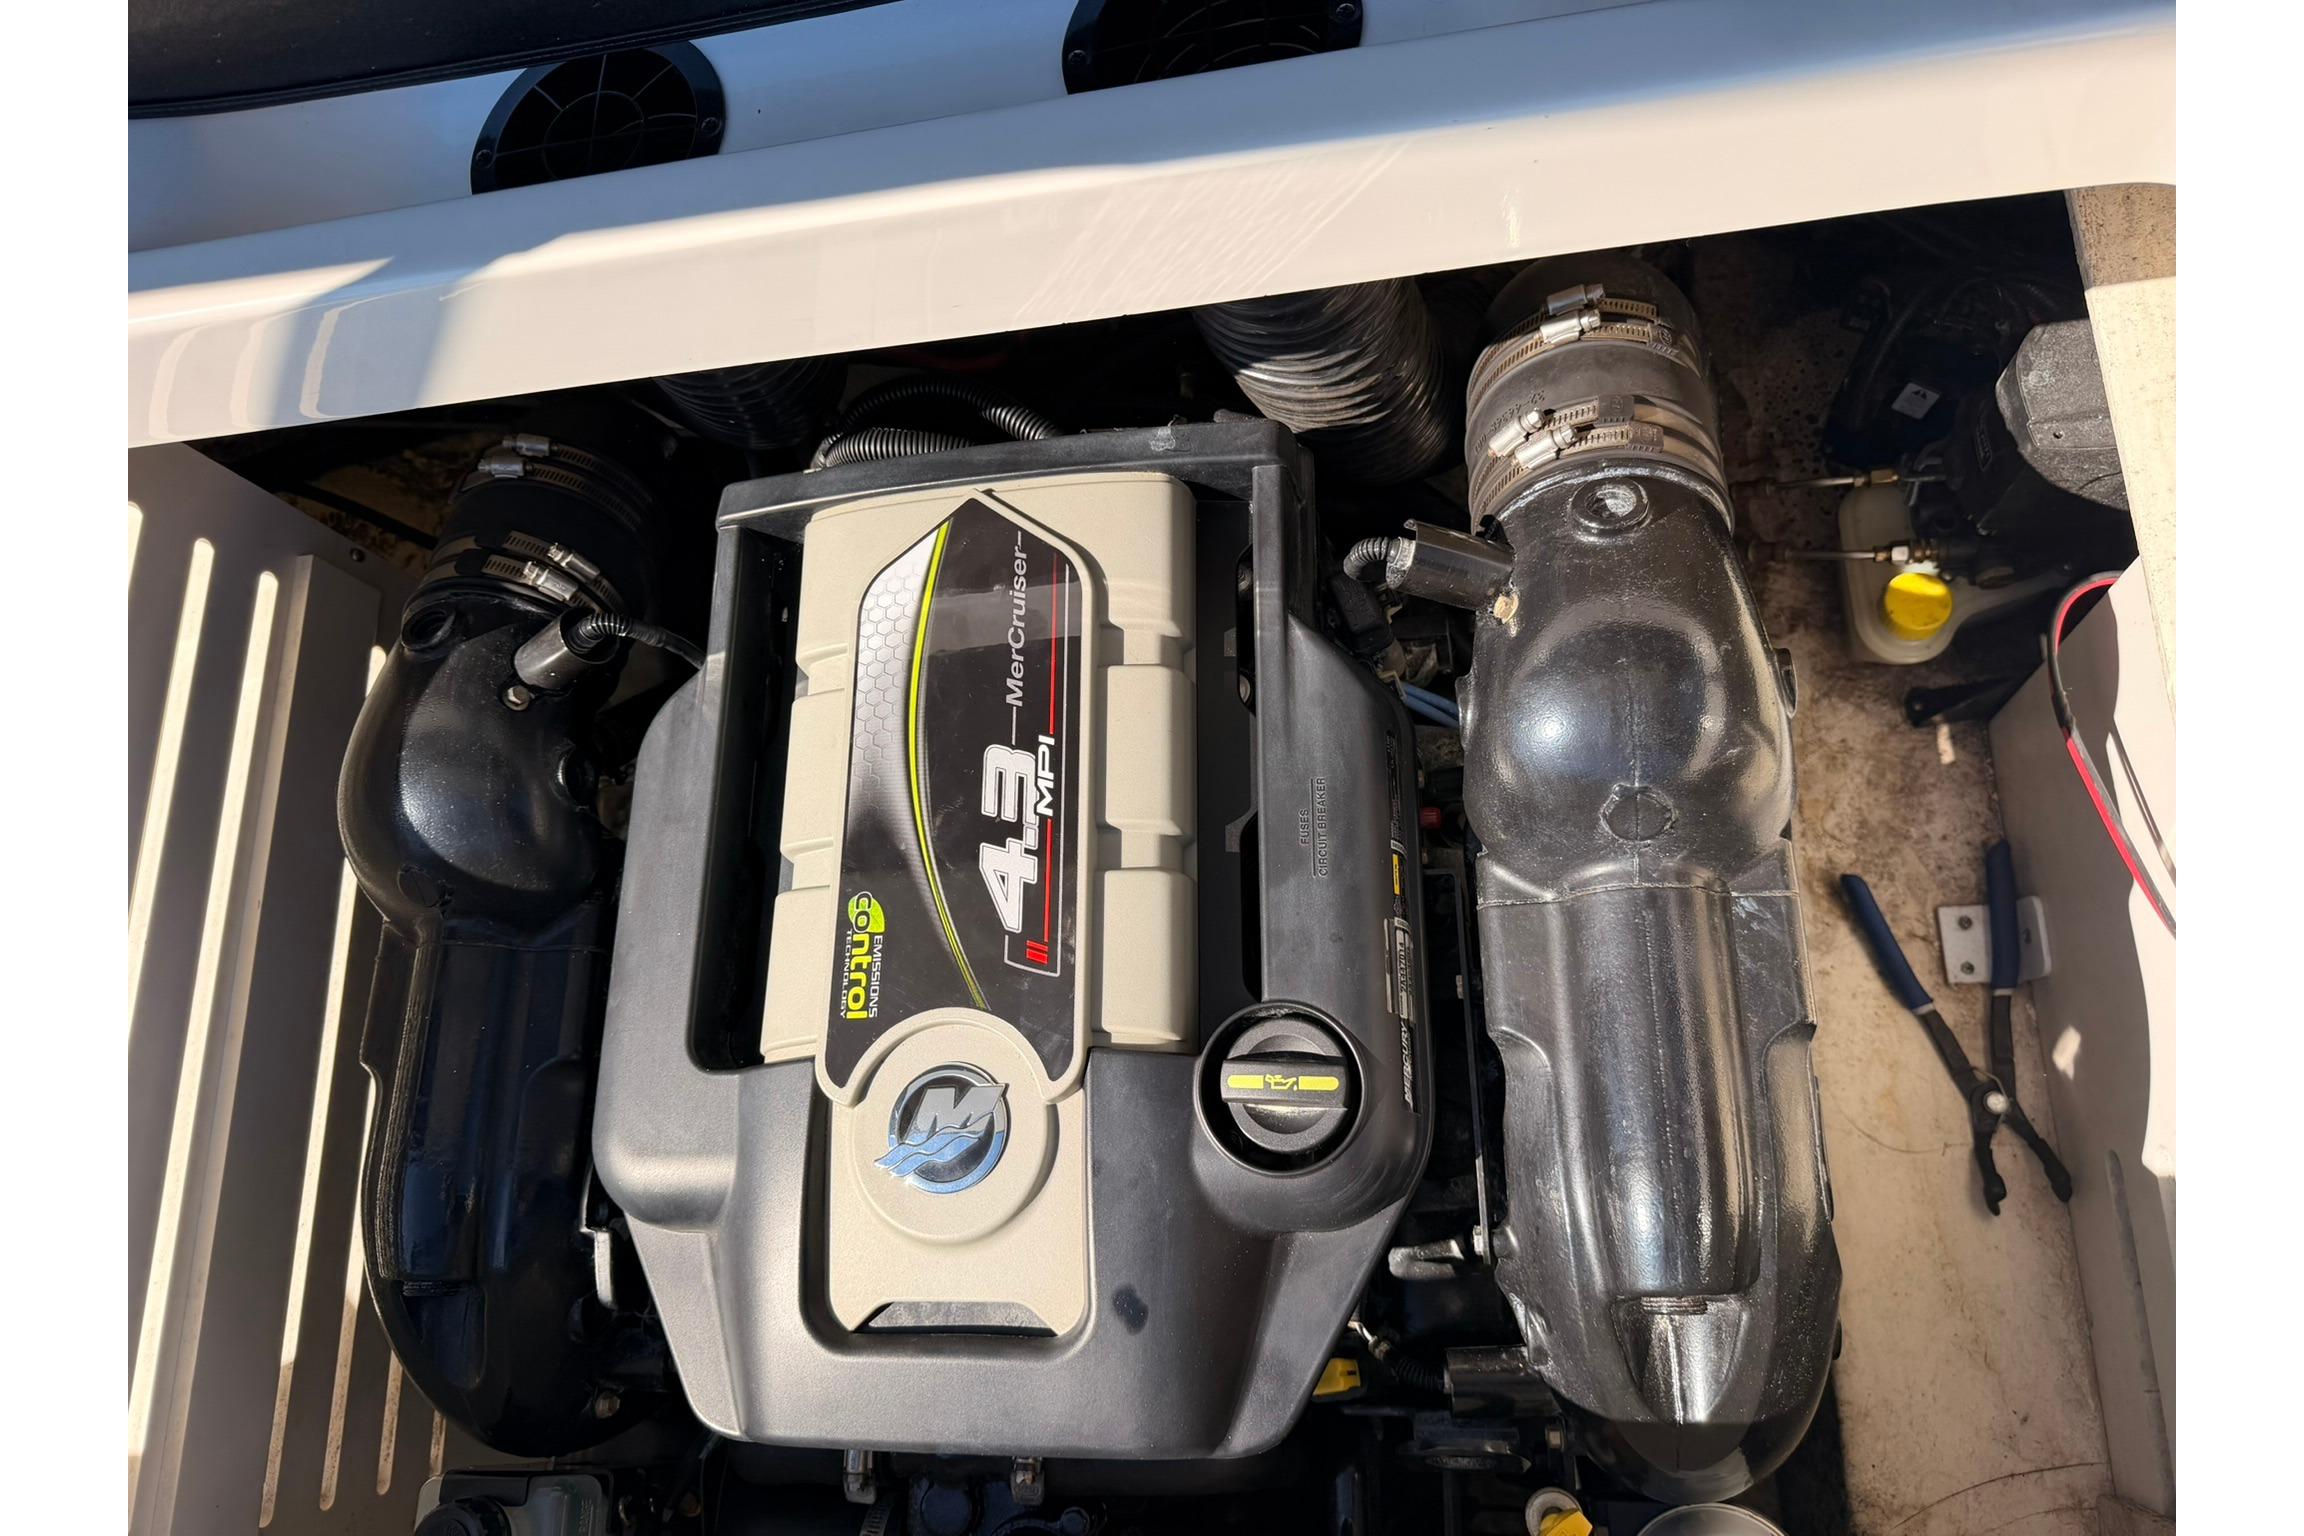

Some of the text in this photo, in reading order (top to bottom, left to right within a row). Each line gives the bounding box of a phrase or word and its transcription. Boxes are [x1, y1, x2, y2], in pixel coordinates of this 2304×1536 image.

[1005, 546, 1027, 707] MerCruiser
[1035, 733, 1055, 817] MPI
[978, 745, 1038, 934] 4.3
[1299, 809, 1309, 845] FUSES
[1316, 777, 1329, 877] CIRCUIT BREAKER
[840, 928, 853, 1019] TECHNOLOGY
[846, 891, 872, 1019] control
[868, 934, 883, 1018] EMISSIONS
[1400, 1020, 1413, 1109] MERCURY
